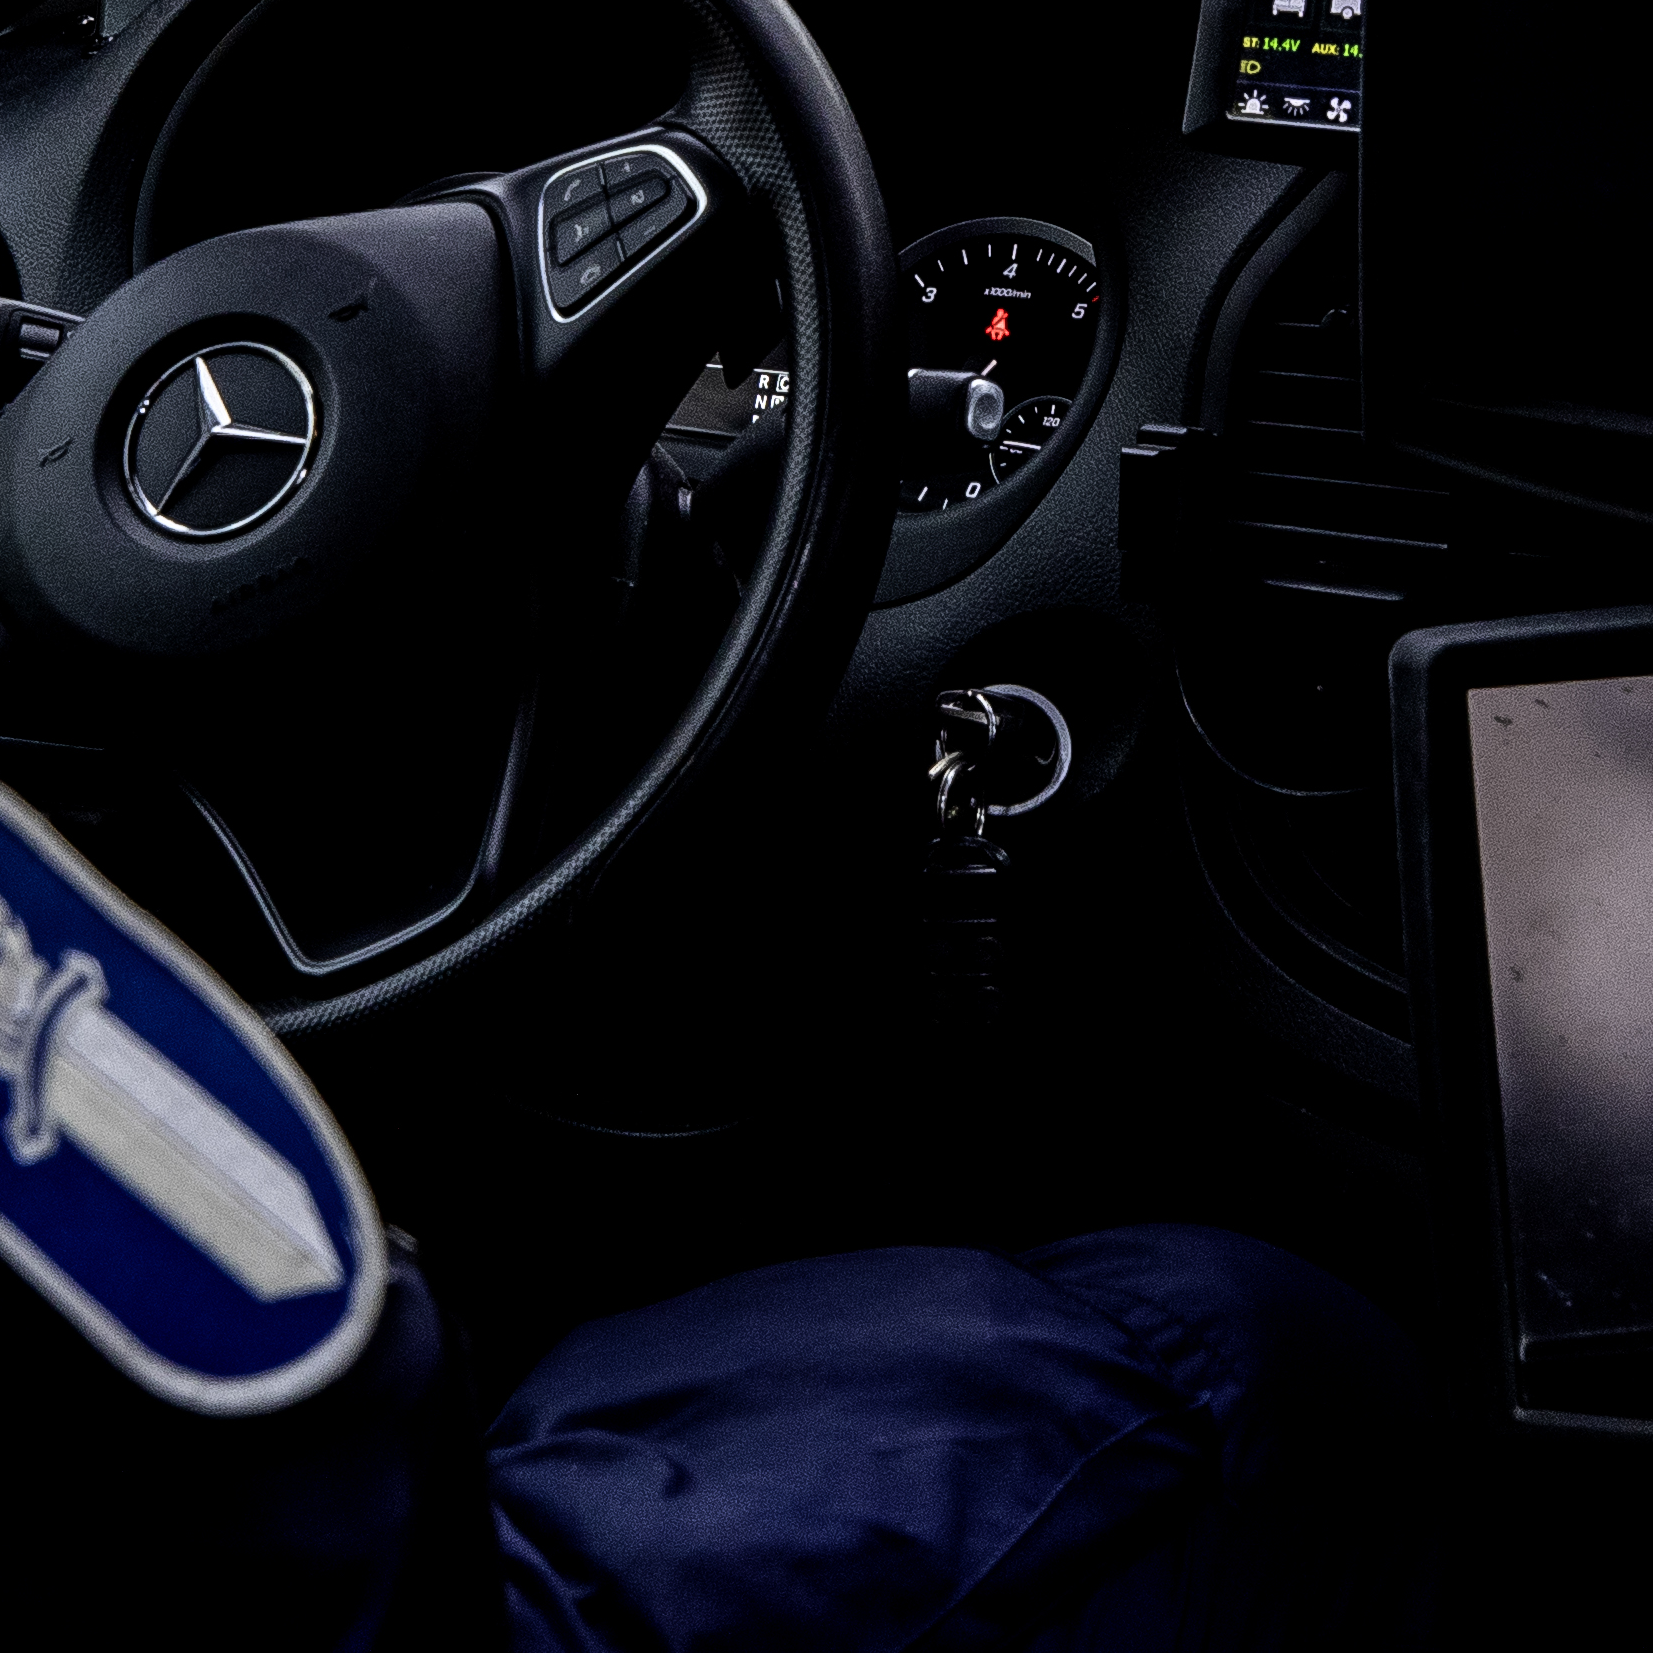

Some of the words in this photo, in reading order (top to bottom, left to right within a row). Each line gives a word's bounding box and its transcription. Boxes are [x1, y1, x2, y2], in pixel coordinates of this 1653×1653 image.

[1262, 37, 1301, 52] 14.4V
[1311, 42, 1340, 56] AUX:
[1002, 262, 1019, 280] 4
[921, 287, 937, 303] 3
[1071, 302, 1088, 320] 5
[758, 374, 770, 389] R
[754, 393, 768, 409] N
[1042, 416, 1061, 427] 120
[965, 481, 981, 498] 0
